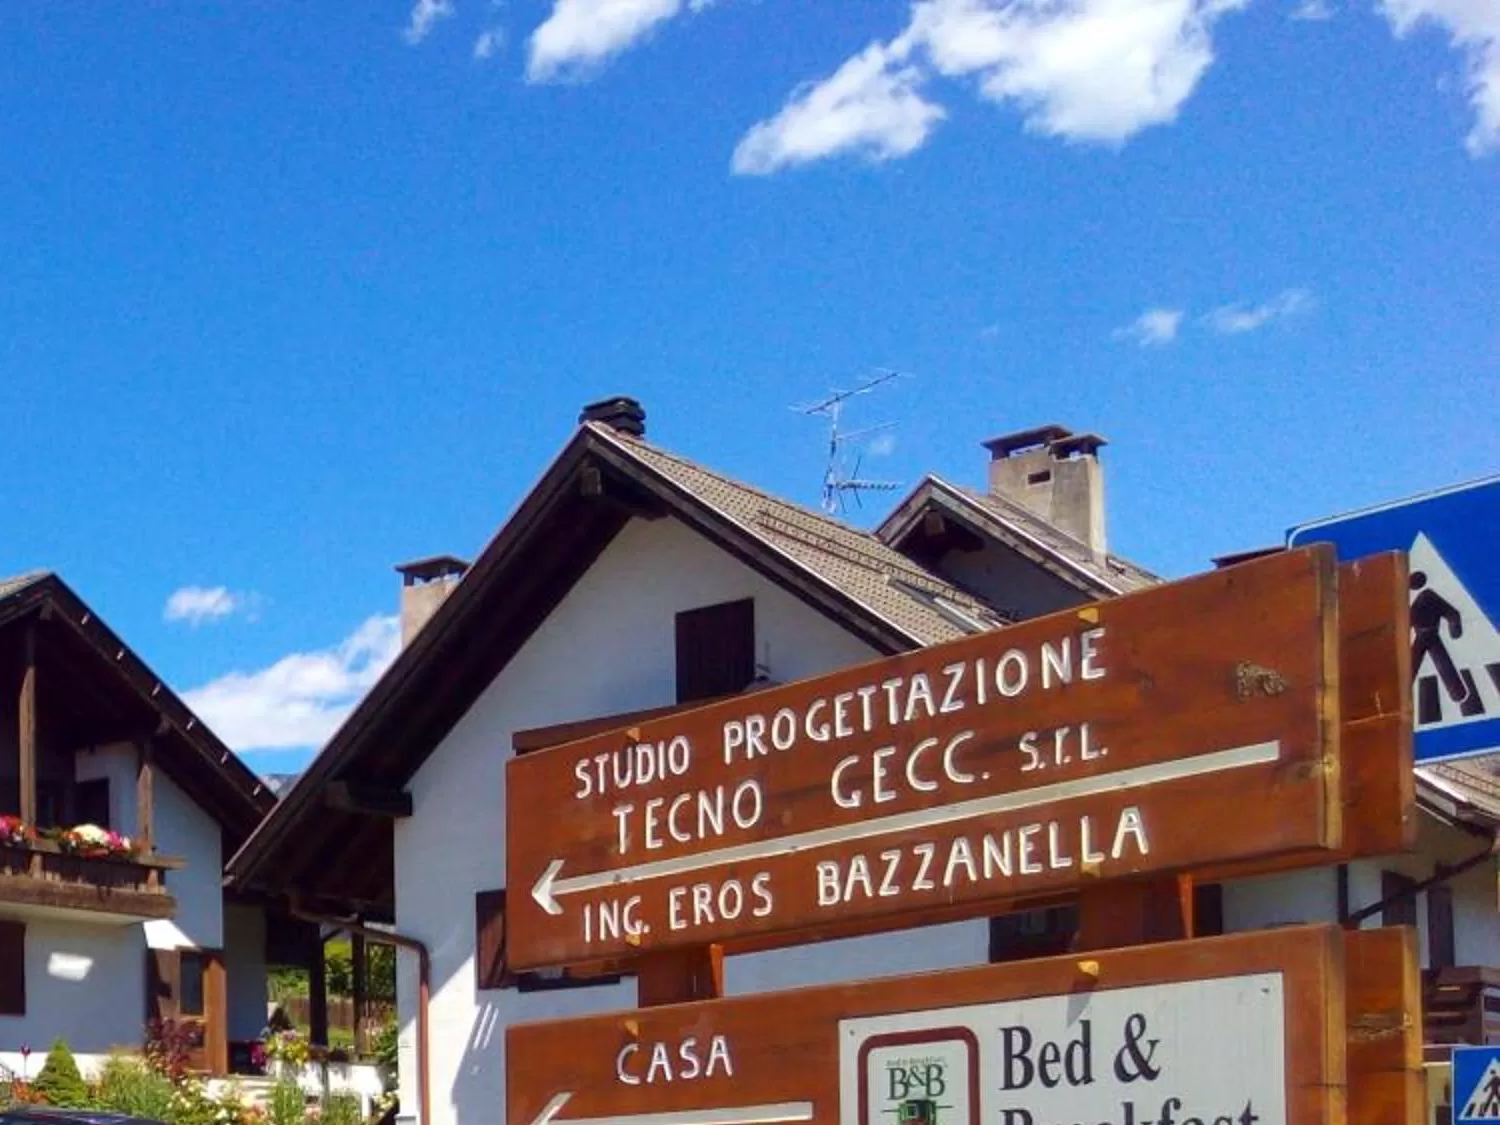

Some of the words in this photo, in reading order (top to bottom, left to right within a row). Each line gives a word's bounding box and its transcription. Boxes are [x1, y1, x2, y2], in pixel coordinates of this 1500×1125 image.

[574, 735, 691, 799] STUDIO
[723, 628, 1108, 765] PROGETTAZIONE
[612, 779, 763, 855] TECNO
[830, 730, 991, 809] GECC.
[583, 895, 651, 944] ING.
[669, 871, 774, 932] EROS
[816, 806, 1150, 907] BAZZANELLA
[617, 1035, 733, 1085] CASA
[885, 1063, 946, 1101] B&B
[998, 1019, 1095, 1091] Bed
[1113, 1012, 1162, 1083] &
